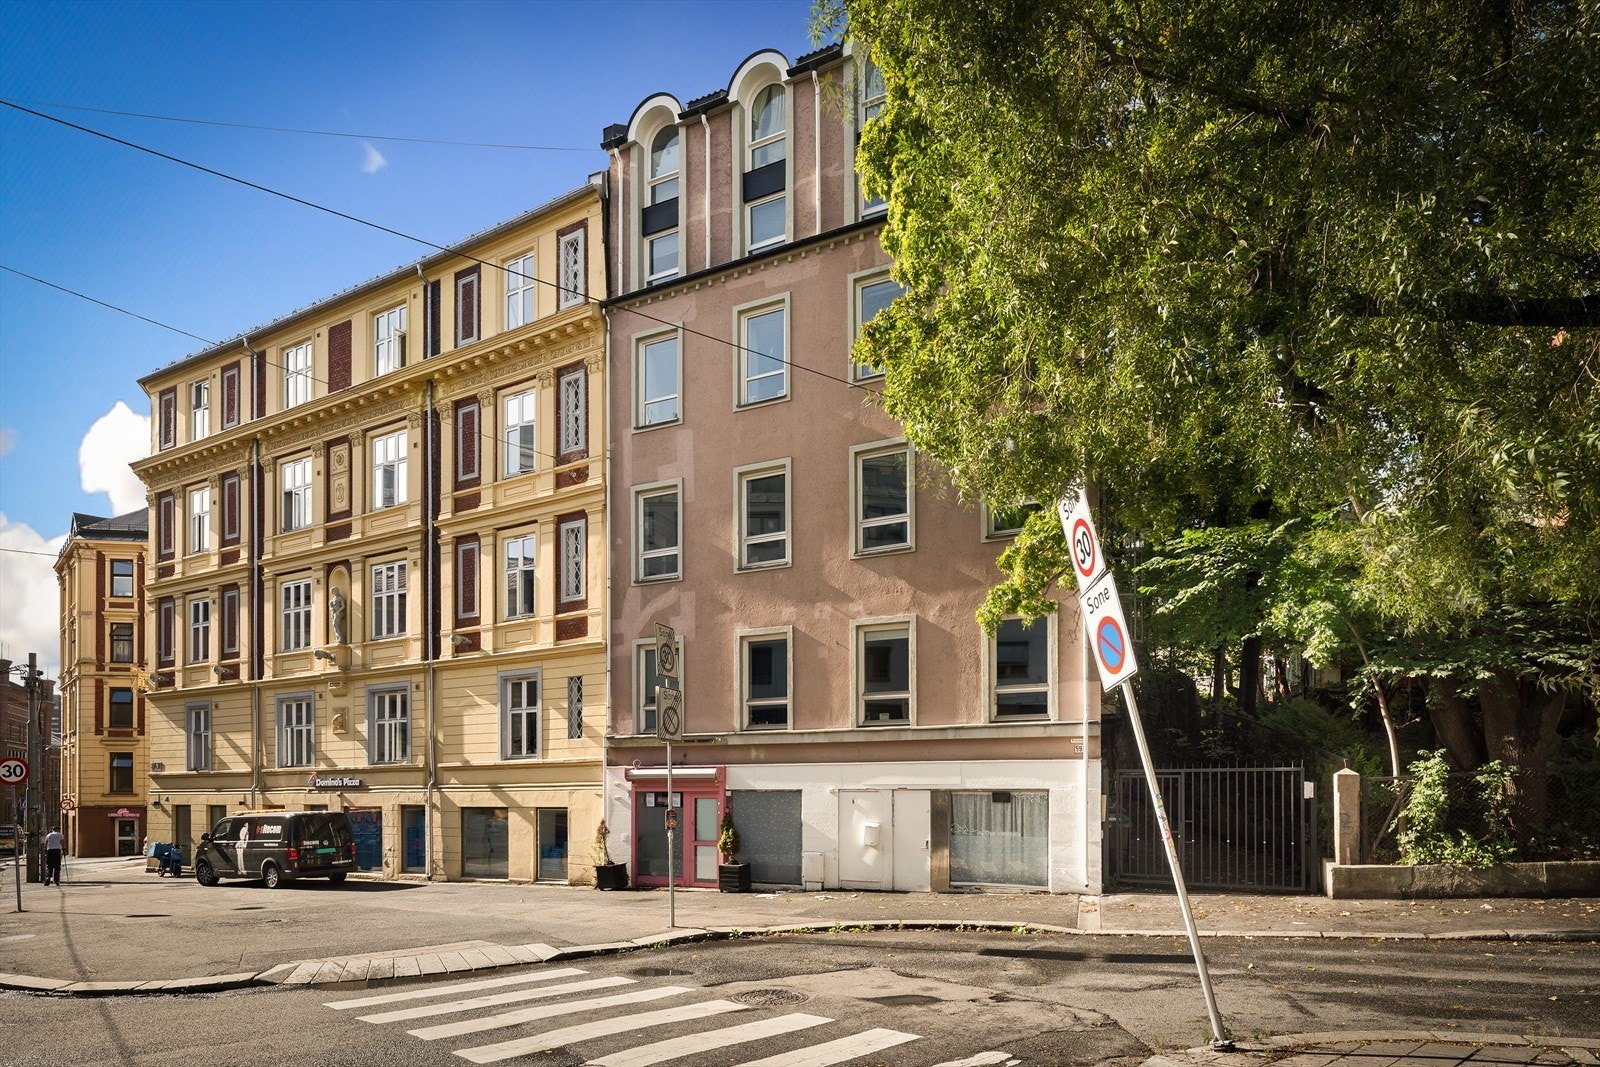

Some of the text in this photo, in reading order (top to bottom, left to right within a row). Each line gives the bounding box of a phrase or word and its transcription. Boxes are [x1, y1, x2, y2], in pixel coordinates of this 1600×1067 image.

[1063, 491, 1080, 520] Son
[1076, 531, 1091, 565] 30
[1087, 587, 1110, 614] Sone
[1, 764, 24, 778] 30
[315, 777, 360, 786] Domino's Pizza
